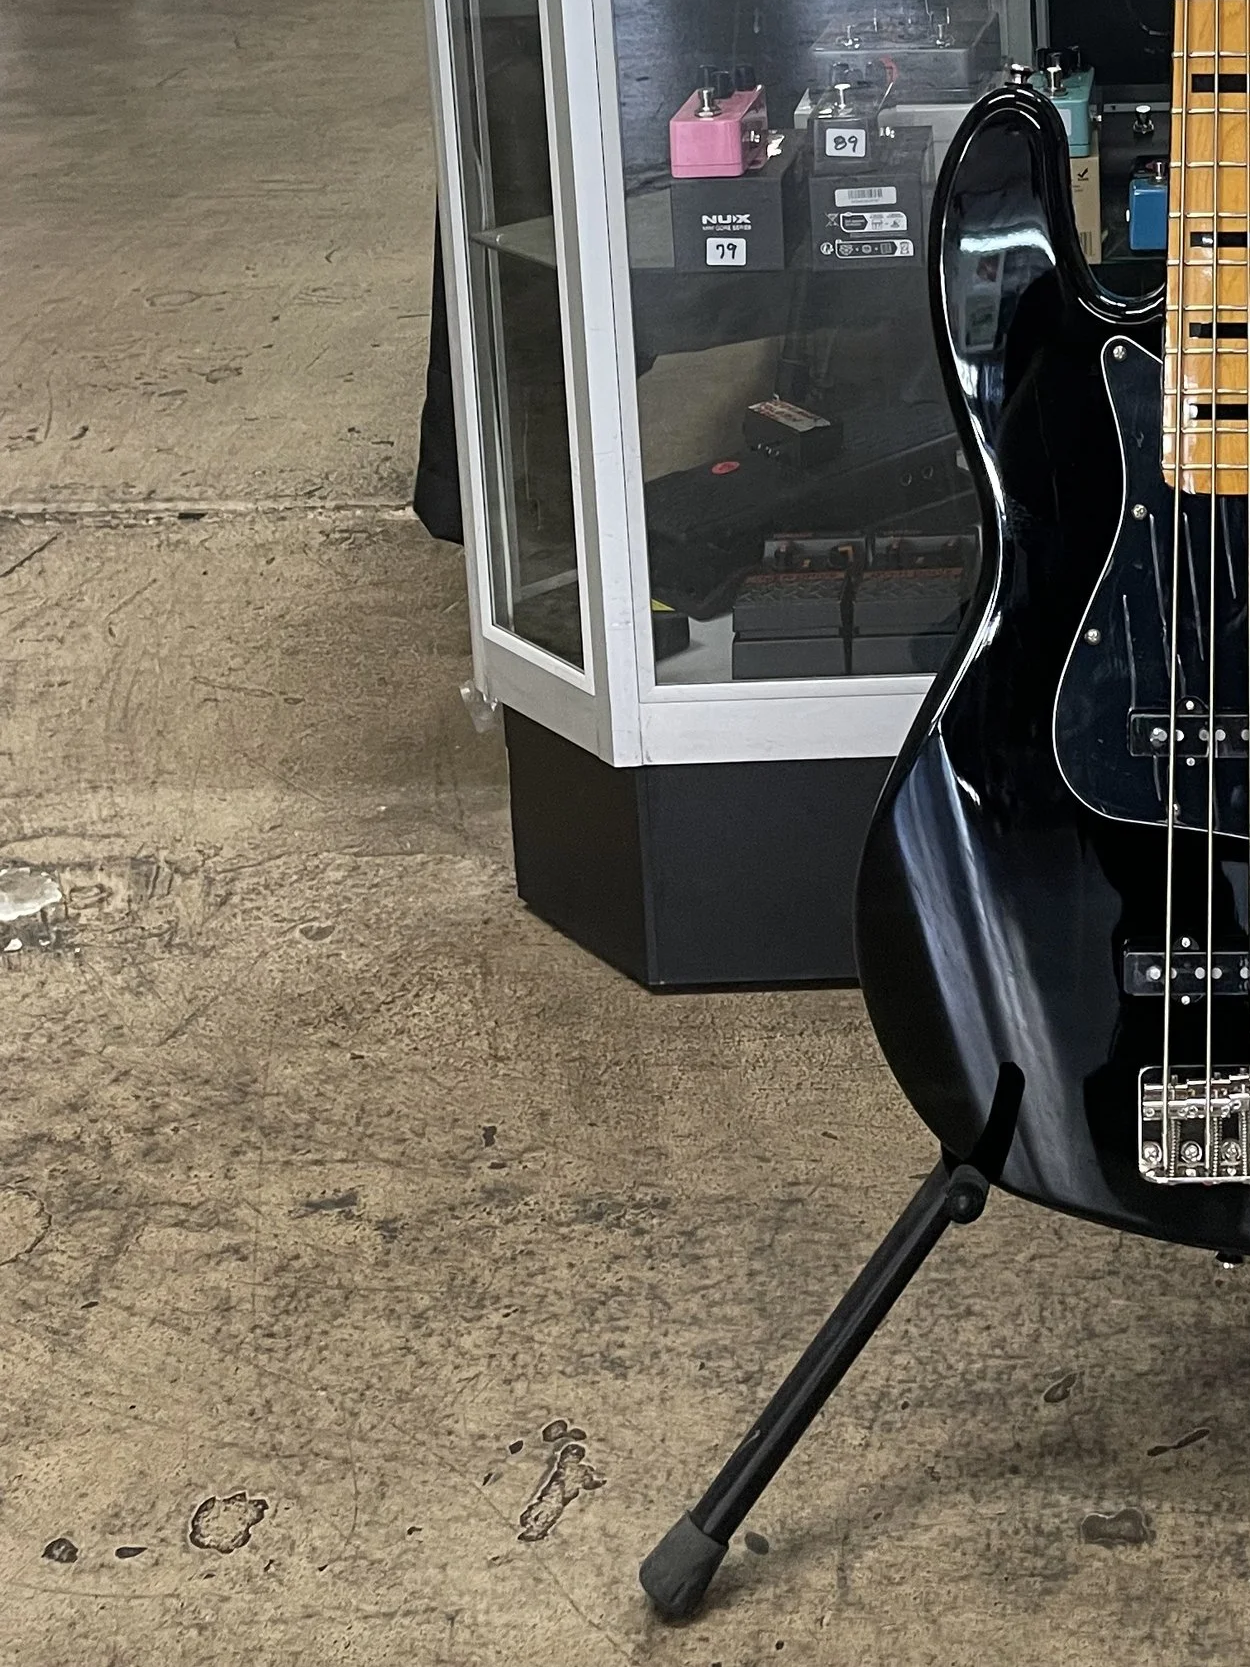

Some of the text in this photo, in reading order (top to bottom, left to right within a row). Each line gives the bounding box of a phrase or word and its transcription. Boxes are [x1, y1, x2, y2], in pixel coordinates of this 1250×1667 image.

[832, 134, 858, 153] 89
[701, 213, 752, 225] NUX
[716, 242, 738, 260] 79
